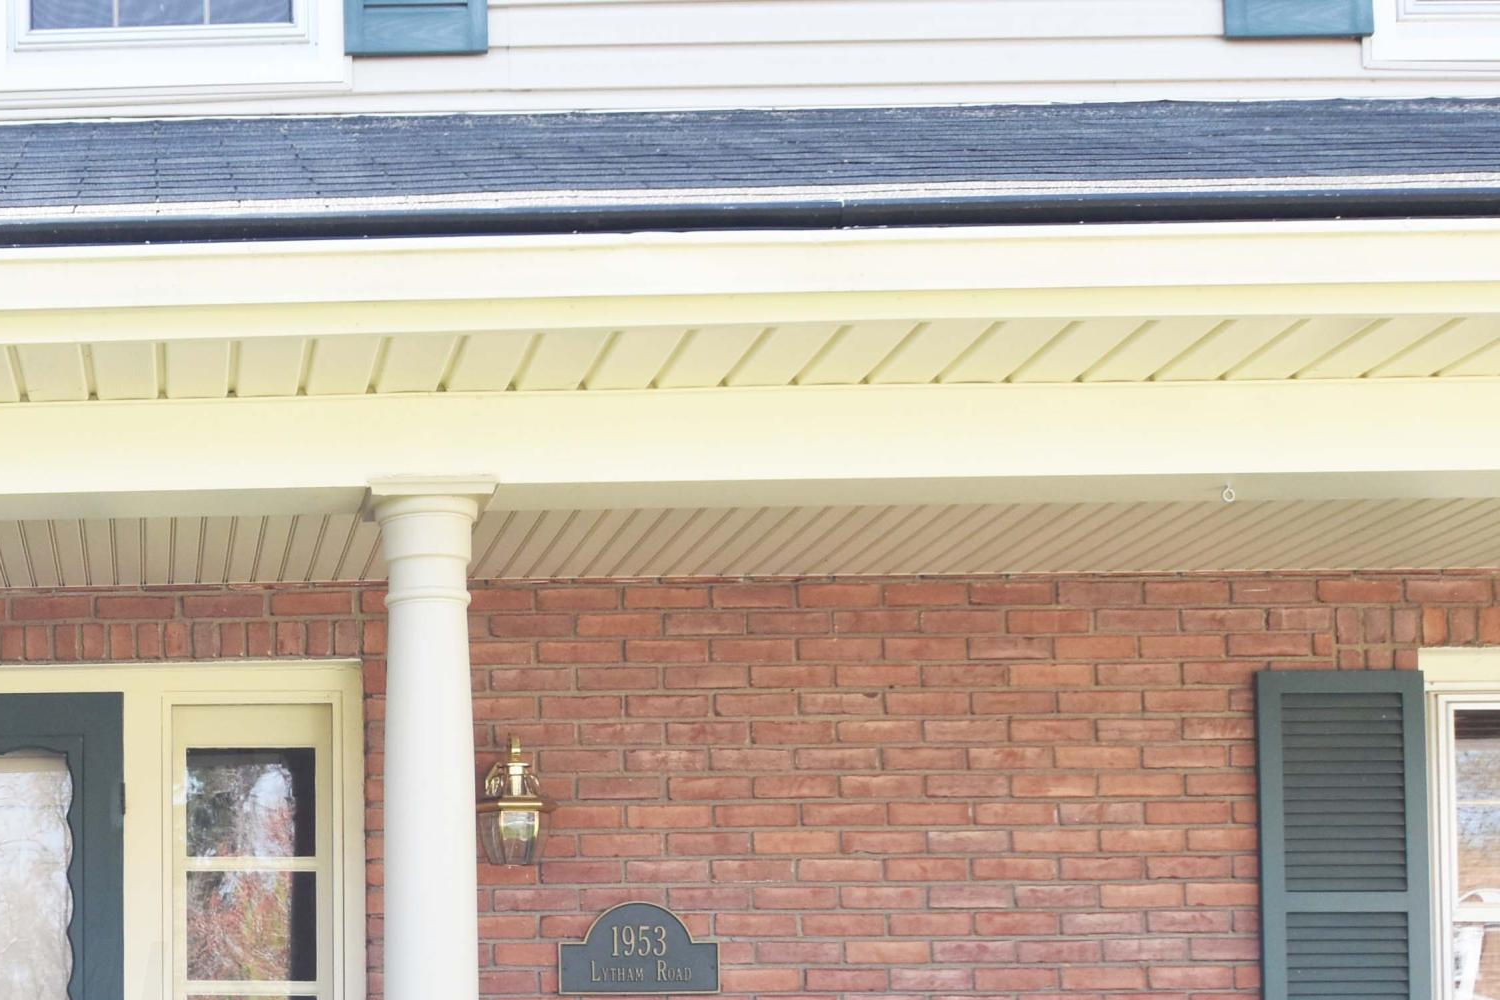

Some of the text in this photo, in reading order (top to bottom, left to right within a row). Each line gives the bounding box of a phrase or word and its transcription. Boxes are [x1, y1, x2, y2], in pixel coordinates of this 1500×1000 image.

[611, 925, 667, 957] 1953
[591, 959, 692, 982] LYTHAM ROAD
